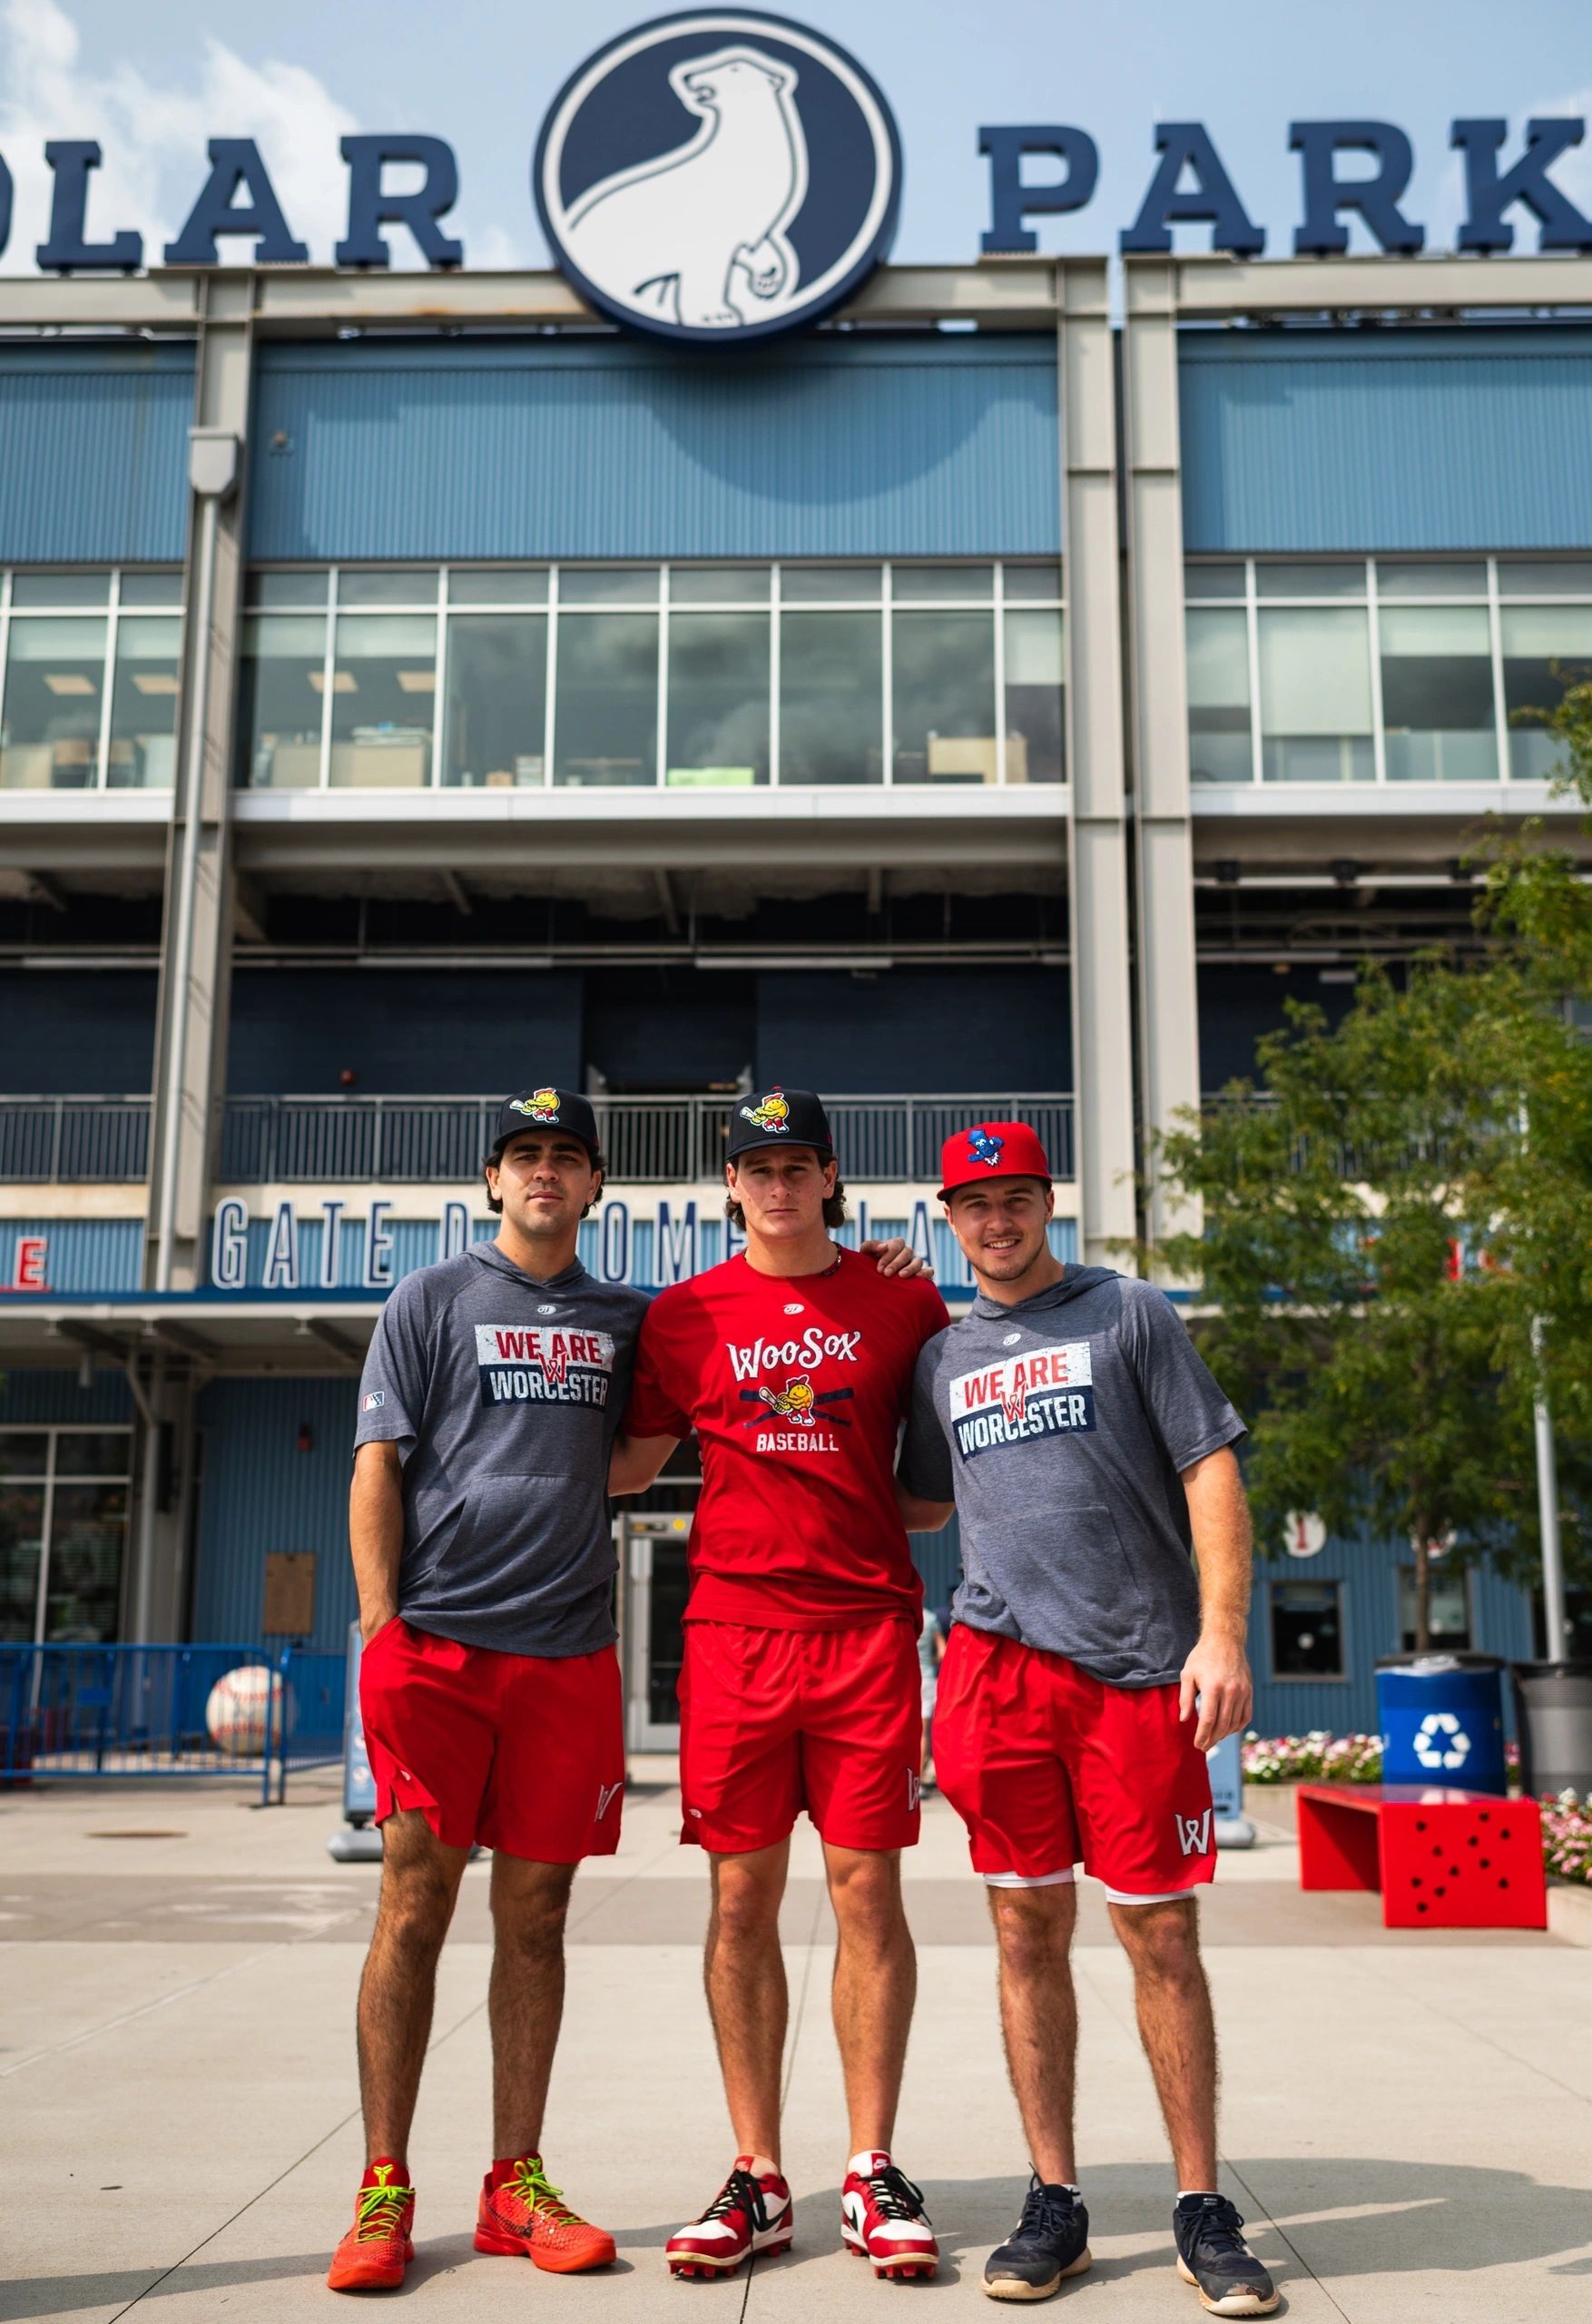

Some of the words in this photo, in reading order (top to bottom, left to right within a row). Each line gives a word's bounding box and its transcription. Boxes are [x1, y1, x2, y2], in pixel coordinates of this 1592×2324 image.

[0, 135, 464, 273] LAR
[978, 118, 1592, 258] PARK
[212, 1196, 394, 1289] GATE
[496, 1331, 542, 1360] WE
[551, 1333, 603, 1364] ARE
[726, 1327, 861, 1382] WooSox
[489, 1371, 609, 1406] WORCESTER
[964, 1369, 1004, 1409] WE
[1013, 1353, 1068, 1393] ARE
[756, 1433, 840, 1452] BASEBALL
[958, 1394, 1087, 1455] WORCESTER
[1174, 1808, 1213, 1856] W
